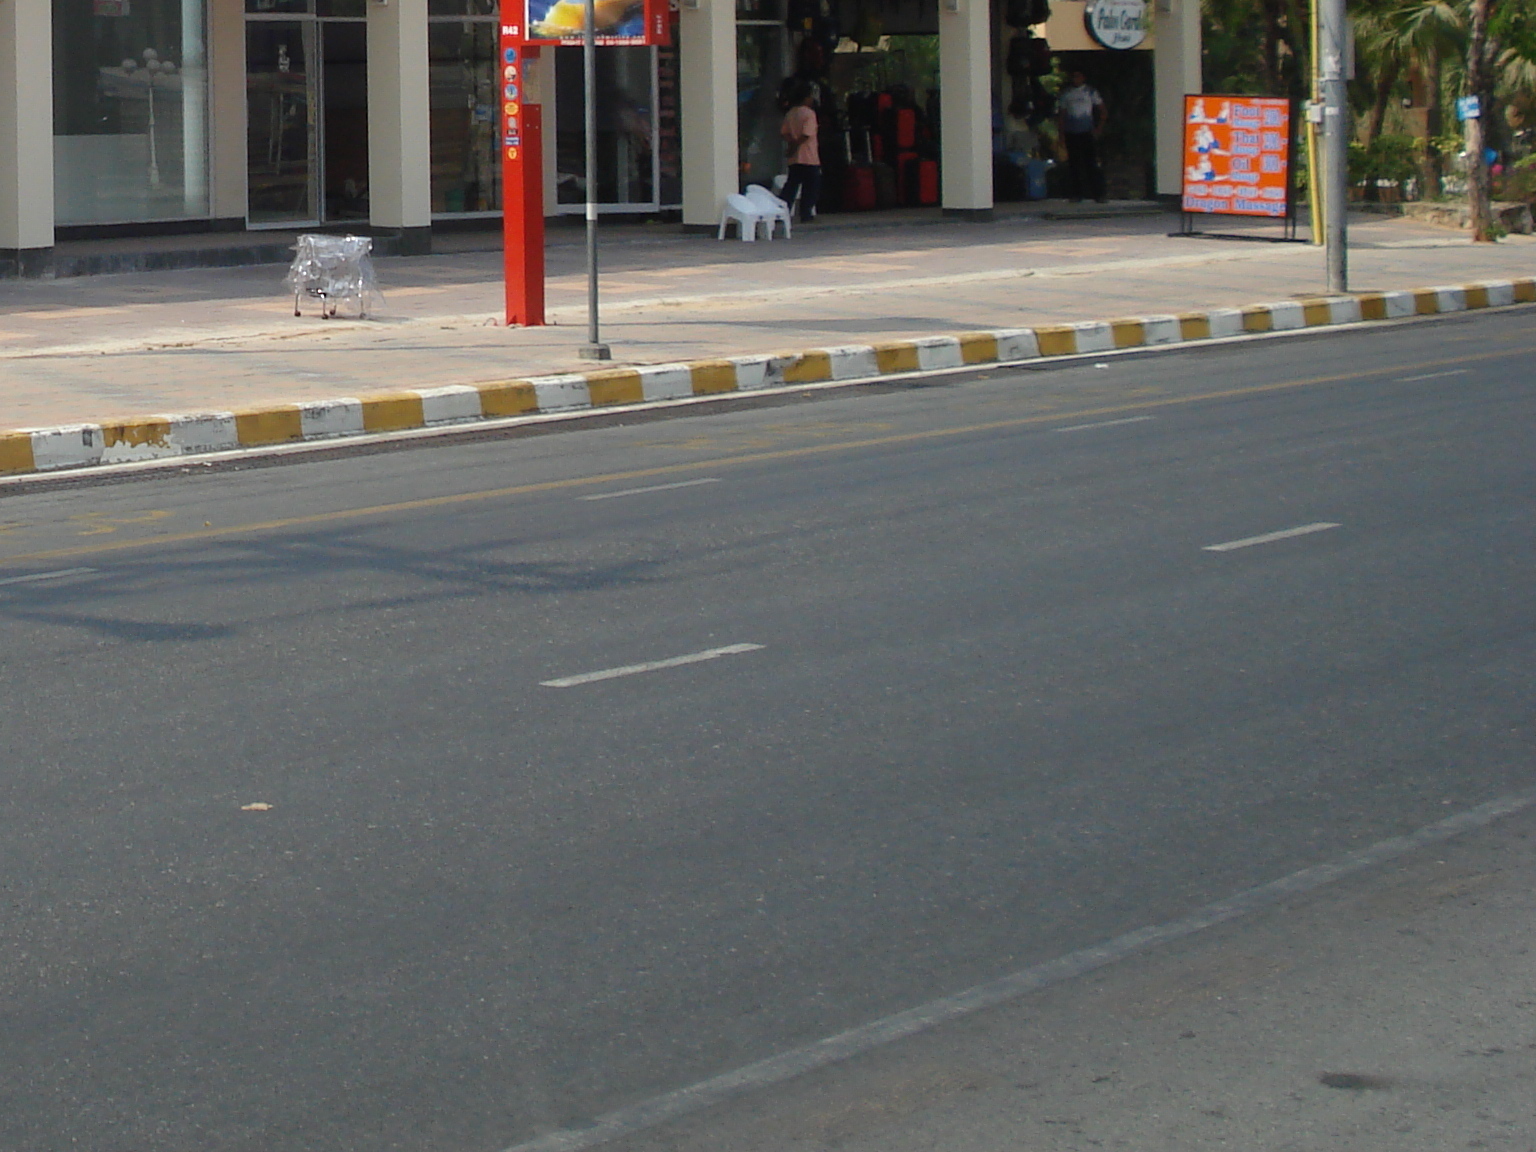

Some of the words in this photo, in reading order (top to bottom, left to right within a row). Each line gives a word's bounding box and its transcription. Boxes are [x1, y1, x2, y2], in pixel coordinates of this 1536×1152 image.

[1233, 131, 1258, 144] Thai
[1232, 157, 1249, 170] Oil
[1186, 196, 1227, 213] Dragon
[1235, 198, 1286, 216] Massage
